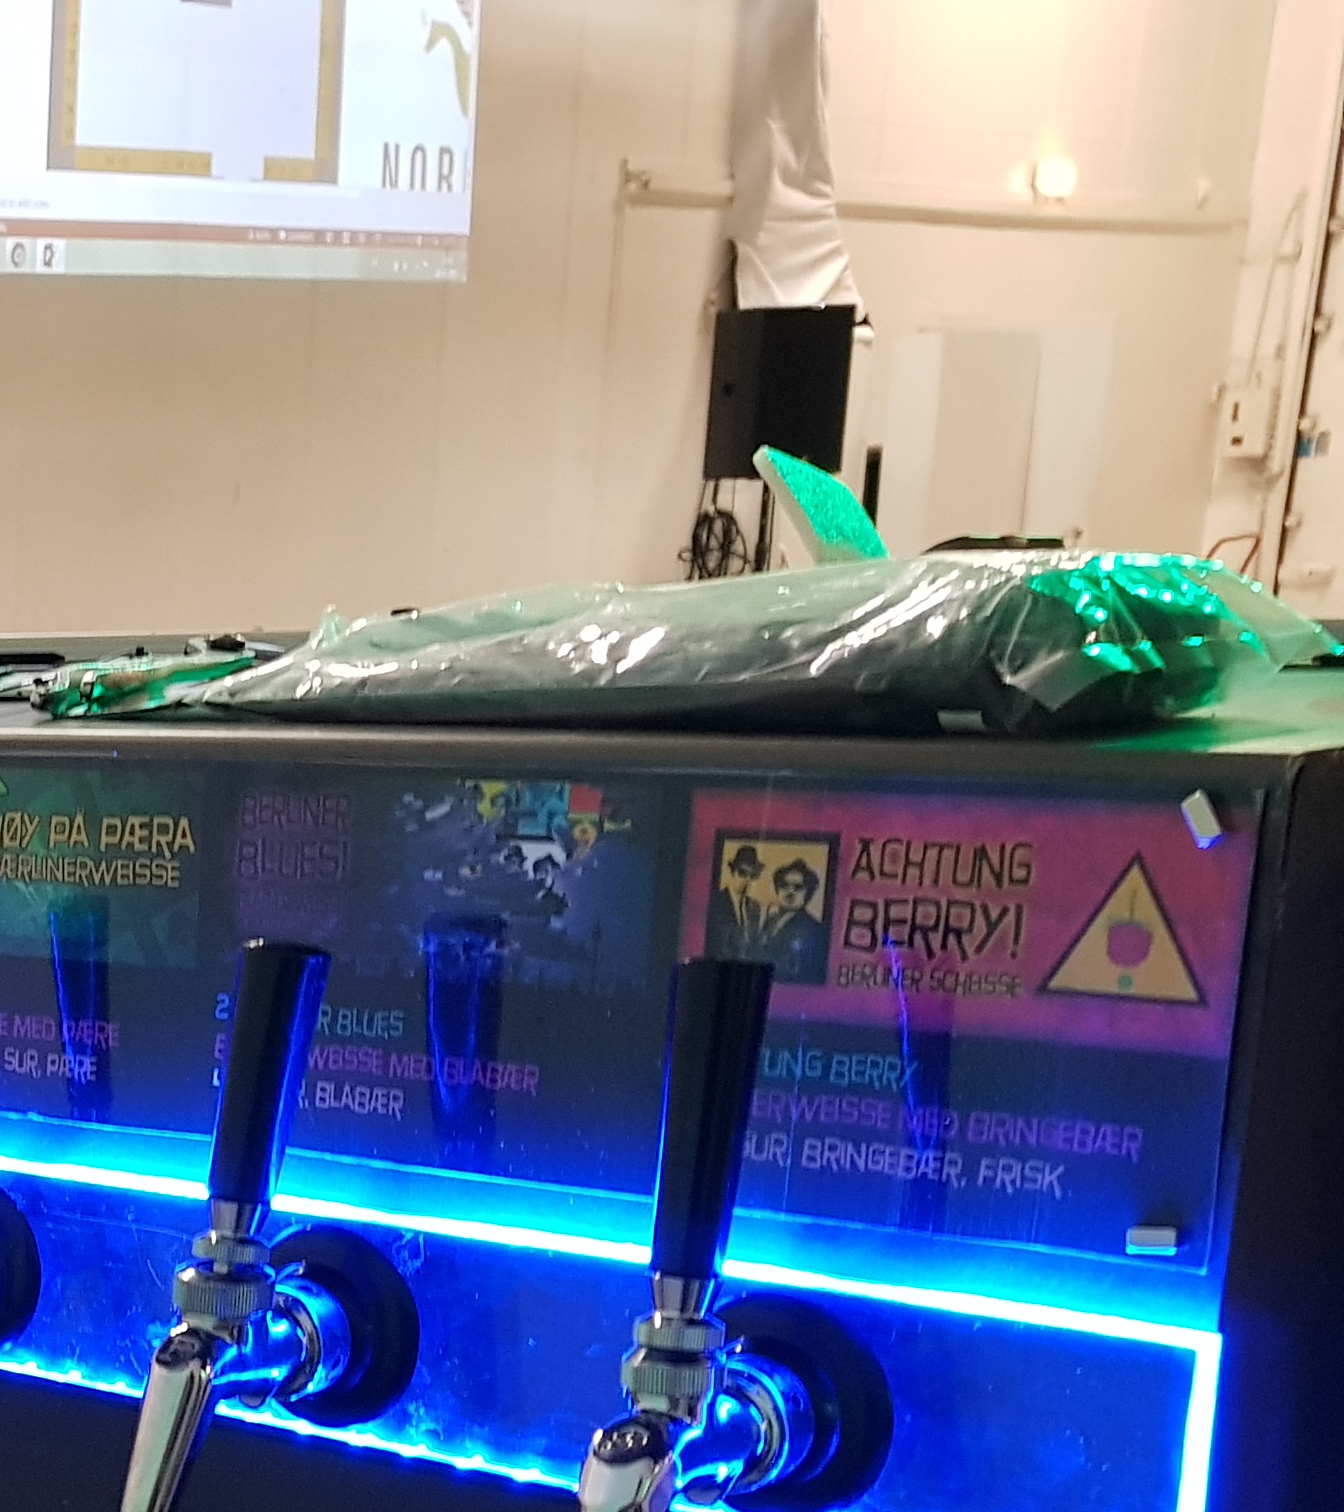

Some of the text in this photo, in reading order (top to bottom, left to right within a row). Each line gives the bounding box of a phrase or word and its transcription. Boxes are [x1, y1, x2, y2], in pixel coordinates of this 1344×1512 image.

[381, 141, 469, 194] NOR
[48, 806, 90, 850] PÅ
[99, 814, 196, 860] PÆRA
[843, 897, 1025, 963] BERRY!
[13, 1012, 56, 1042] MED
[336, 1007, 406, 1040] BLUES
[3, 1045, 42, 1080] SUR,
[307, 1043, 384, 1075] WEISSE
[829, 1055, 918, 1093] BERRY
[751, 1087, 894, 1130] ERWEISSE
[976, 1156, 1066, 1200] FRISK
